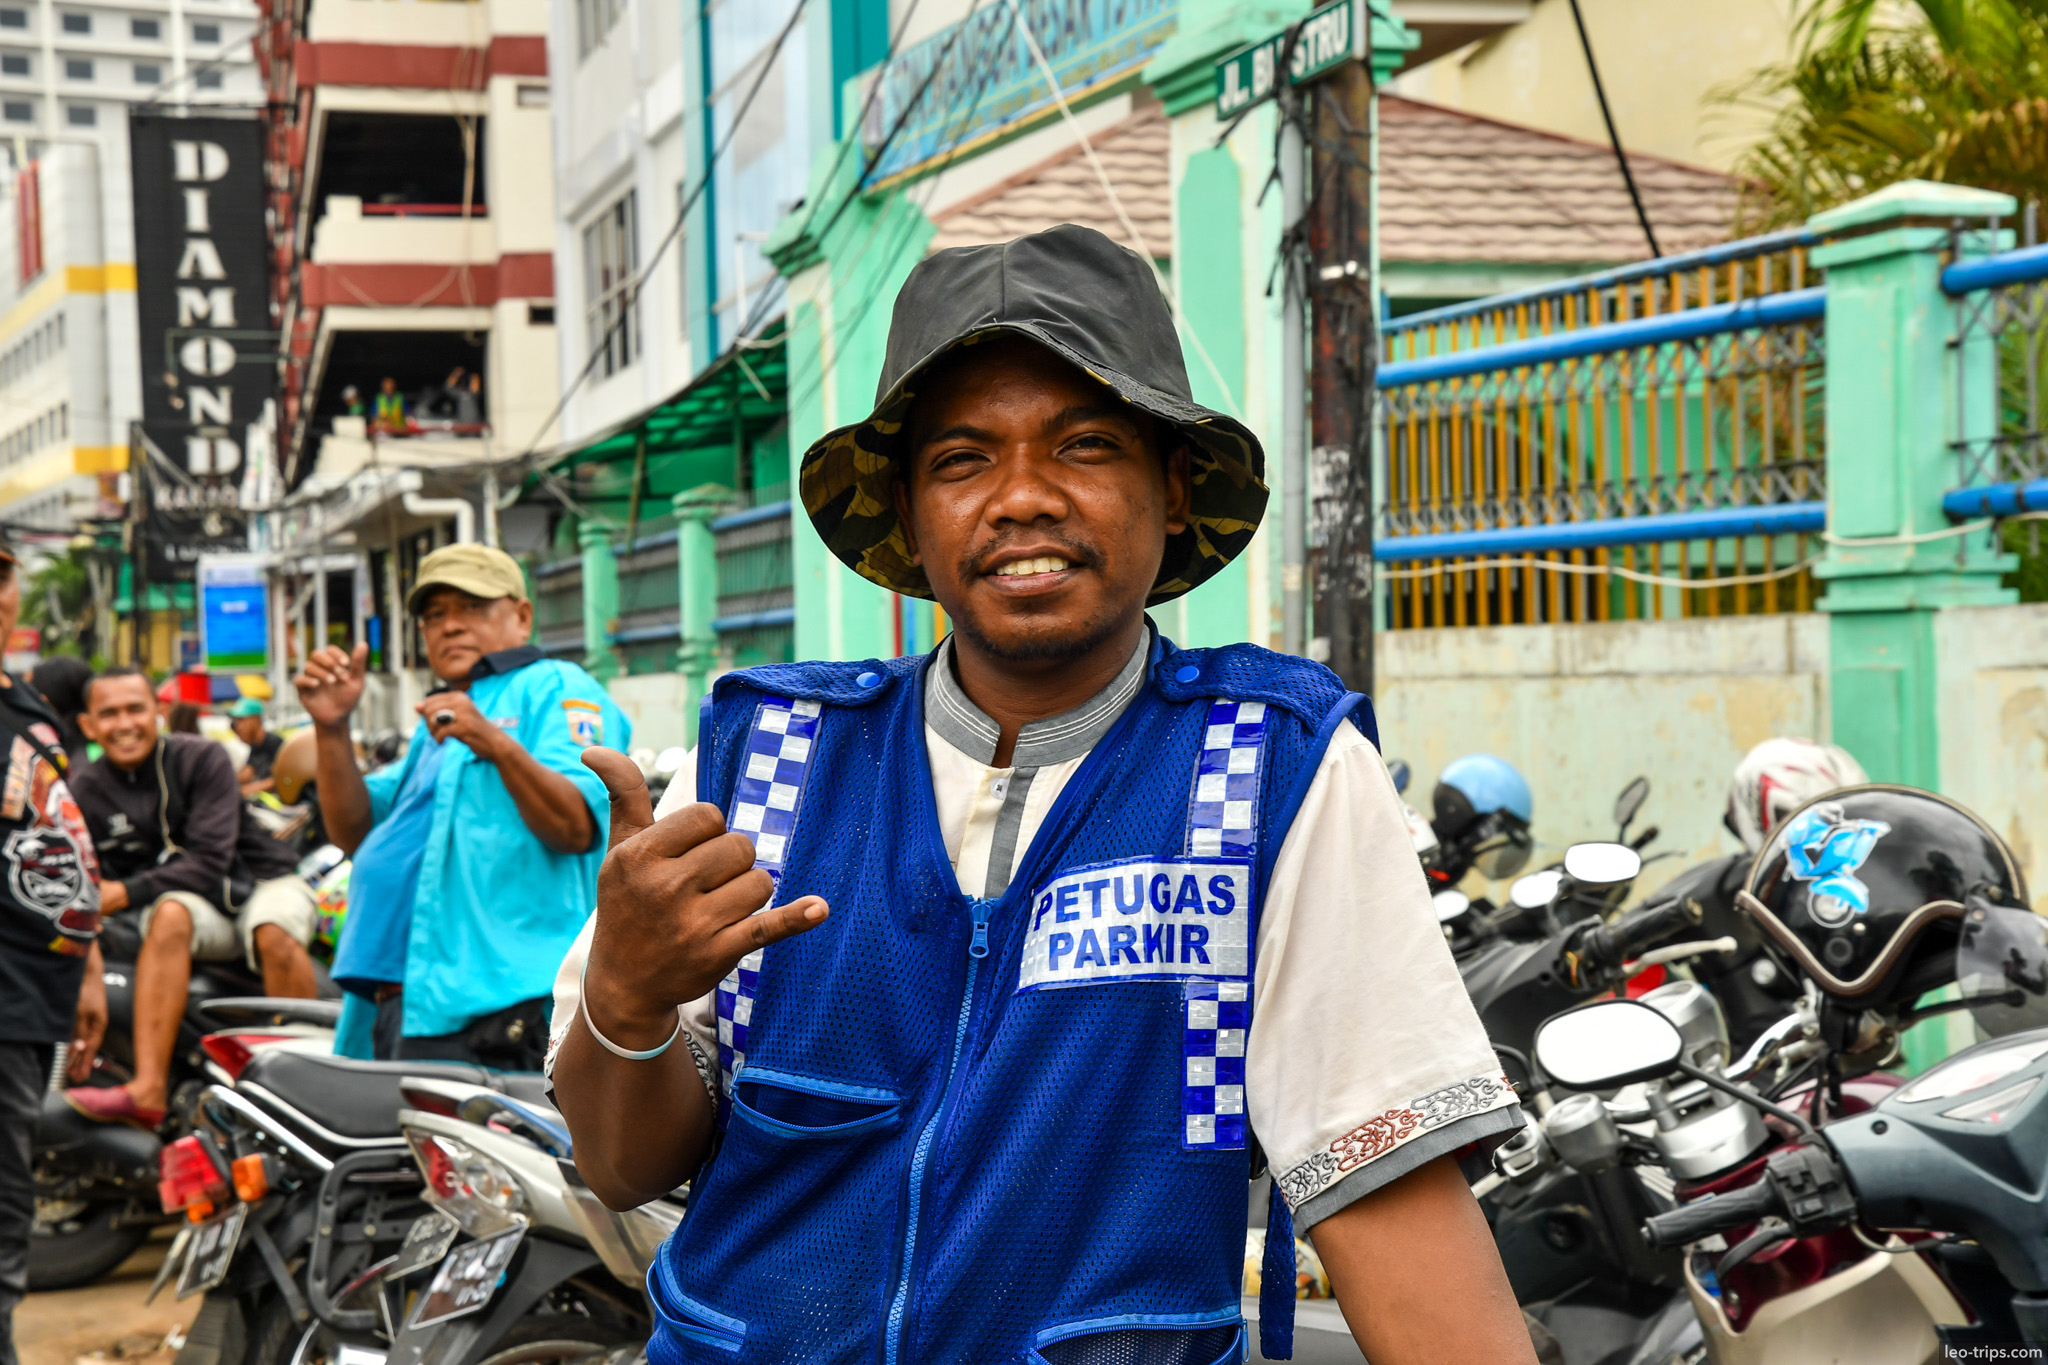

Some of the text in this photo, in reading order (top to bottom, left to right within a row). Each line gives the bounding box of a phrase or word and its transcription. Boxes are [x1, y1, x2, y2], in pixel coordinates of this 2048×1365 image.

[1218, 60, 1250, 112] JL.
[171, 139, 242, 476] DIAMOND
[1033, 872, 1236, 932] PETUGAS
[1048, 923, 1211, 972] PARKIR
